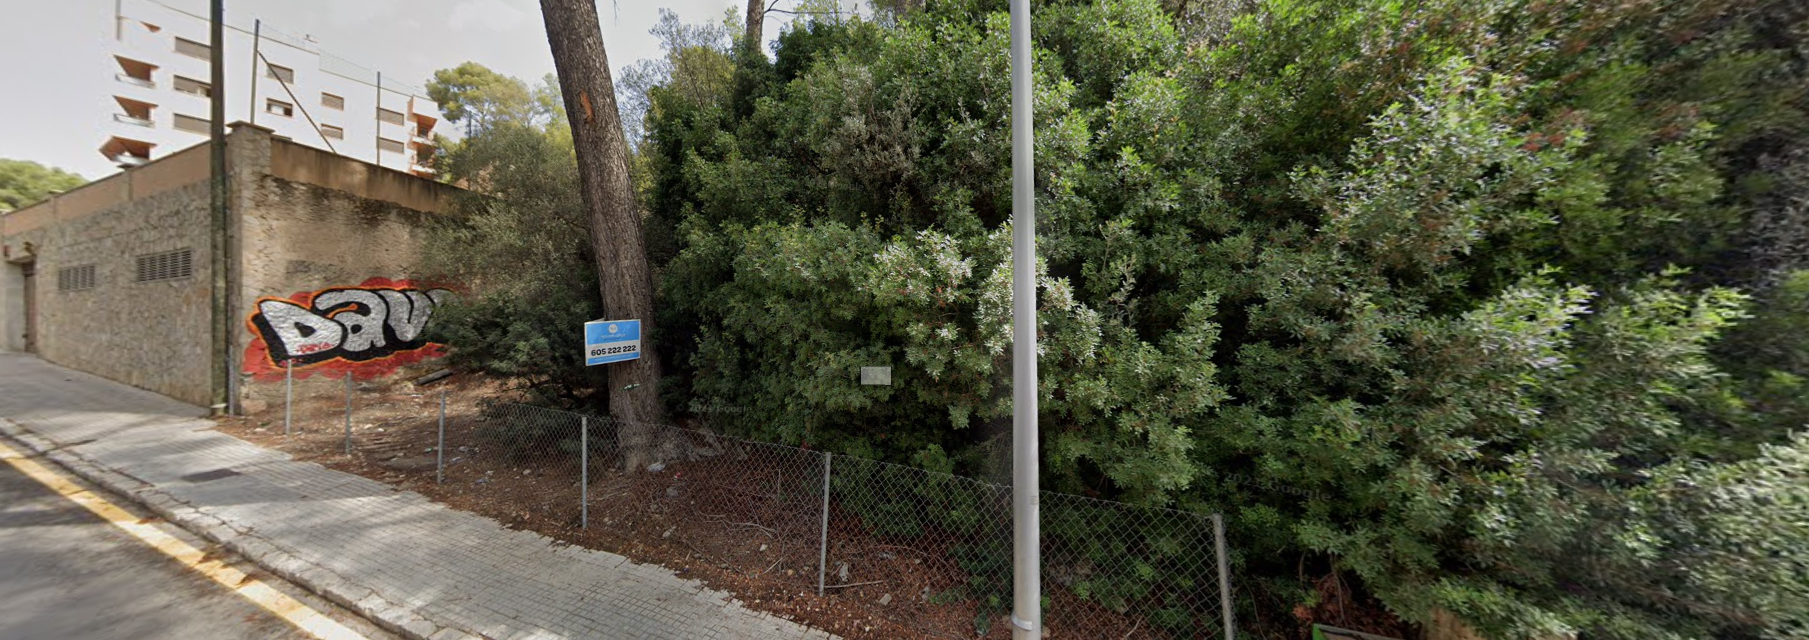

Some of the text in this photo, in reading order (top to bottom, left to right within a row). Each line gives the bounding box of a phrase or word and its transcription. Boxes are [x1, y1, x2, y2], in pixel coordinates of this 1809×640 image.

[591, 344, 636, 357] 605 222 222
